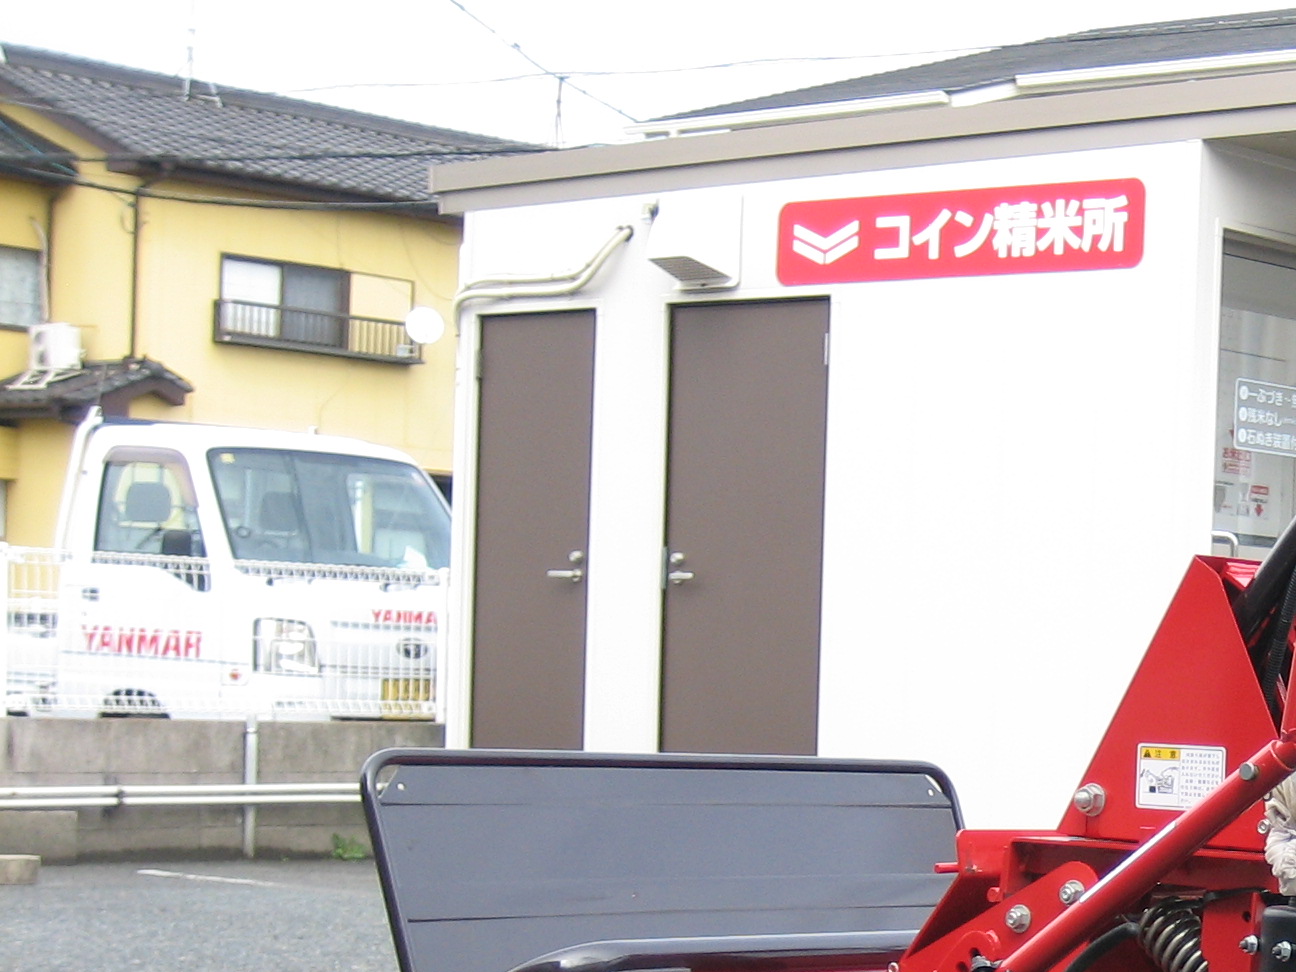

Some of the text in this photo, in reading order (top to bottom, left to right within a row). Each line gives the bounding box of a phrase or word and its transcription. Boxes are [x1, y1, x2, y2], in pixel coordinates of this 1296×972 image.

[874, 195, 1129, 259] コイン精米所
[371, 609, 438, 624] YANMA
[81, 622, 202, 660] YANMAR
